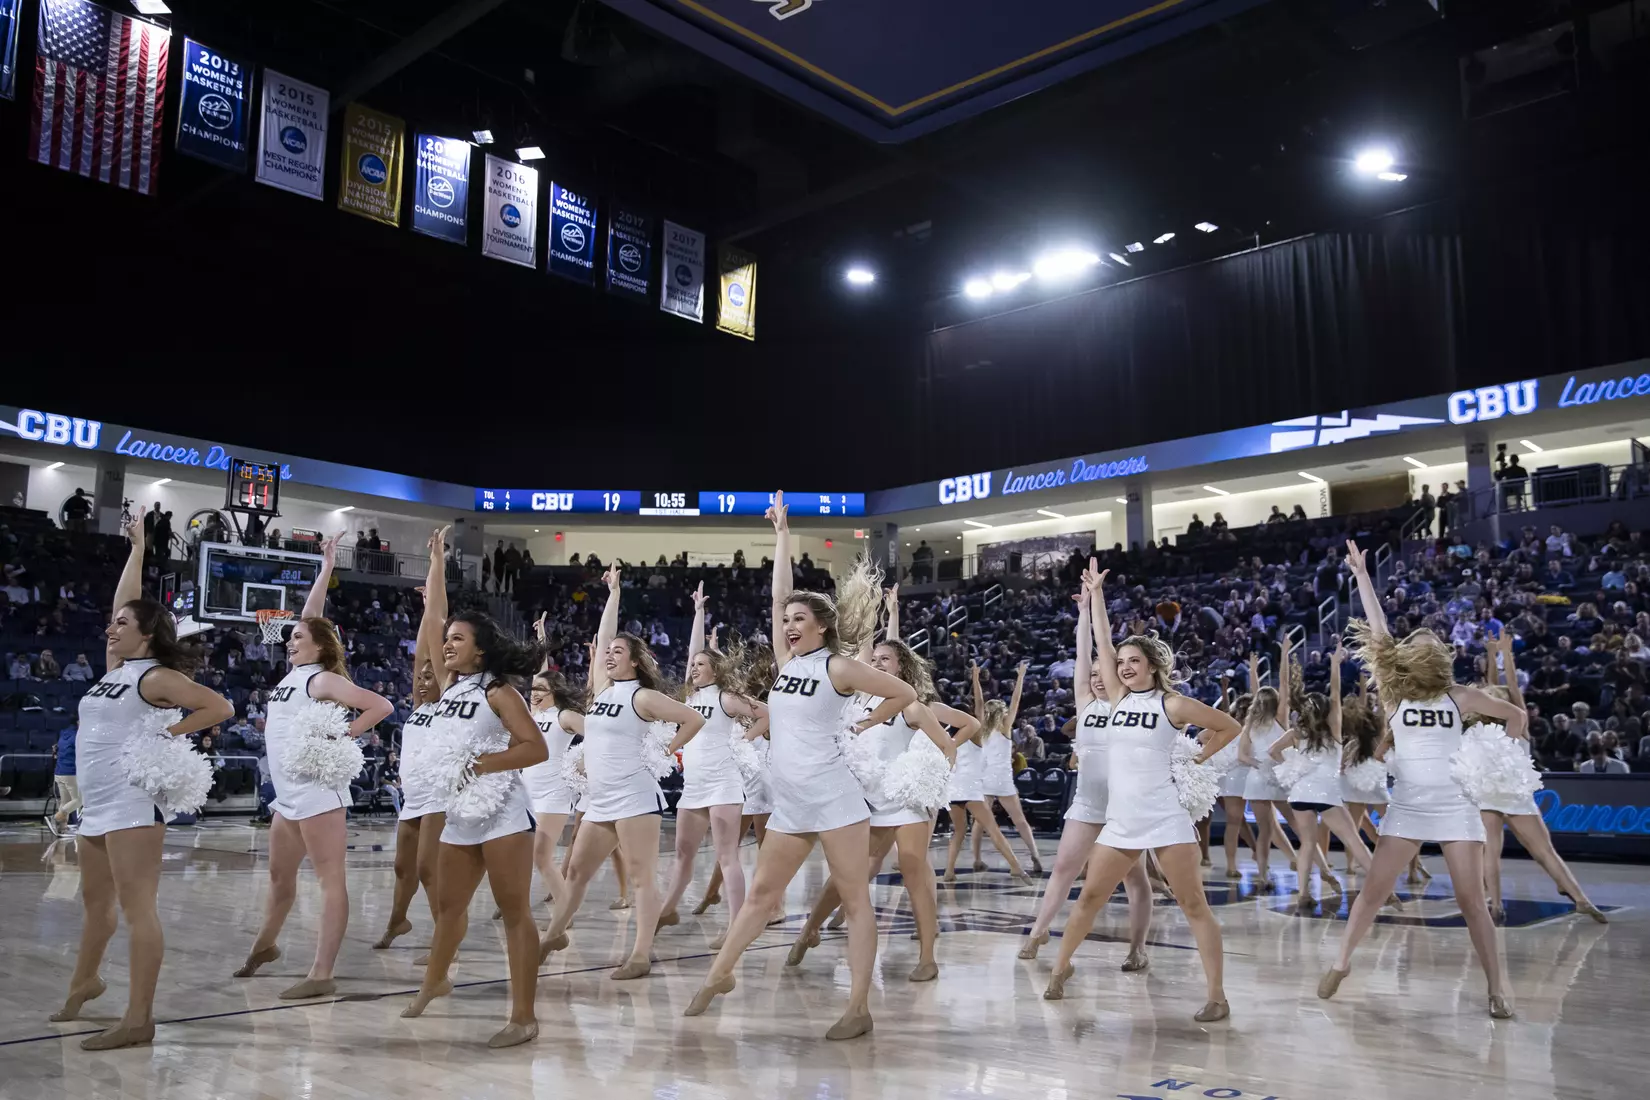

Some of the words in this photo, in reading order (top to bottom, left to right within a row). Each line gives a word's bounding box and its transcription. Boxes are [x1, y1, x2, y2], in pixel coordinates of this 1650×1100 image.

[200, 50, 239, 76] 2013
[192, 63, 243, 89] WOMEN'S
[279, 84, 314, 106] 2015
[272, 97, 317, 119] WOMEN'S
[266, 105, 325, 132] BASKETBALL
[358, 115, 391, 136] 2015
[182, 123, 245, 151] CHAMPIONS
[264, 150, 286, 163] WEST
[288, 155, 321, 174] REGION
[264, 160, 317, 182] CHAMPIONS
[417, 158, 466, 181] BASKETBALL
[497, 167, 525, 185] 2016
[347, 181, 387, 199] DIVISION
[488, 186, 534, 207] BASKETBALL
[492, 179, 528, 196] WOMEN'S
[561, 188, 588, 207] 2017
[343, 197, 381, 214] RUNNER
[347, 188, 393, 209] NATIONAL
[556, 199, 590, 218] WOMEN'S
[415, 204, 464, 226] CHAMPIONS
[553, 207, 596, 229] BASKETBALL
[618, 211, 644, 228] 2017
[486, 233, 534, 253] TOURNAMENT
[492, 228, 522, 244] DIVISION
[551, 249, 594, 268] CHAMPIONS
[1448, 379, 1539, 425] CBU
[18, 409, 101, 449] CBU
[115, 430, 200, 466] Lancer
[939, 472, 992, 505] CBU
[1002, 468, 1066, 495] Lancer
[1070, 456, 1149, 483] Dancers
[483, 501, 494, 510] FLS
[505, 502, 510, 510] 2
[484, 491, 495, 499] TOL
[505, 491, 511, 500] 4
[531, 492, 574, 511] CBU
[603, 492, 621, 511] 19
[654, 492, 686, 508] 10:55
[718, 494, 736, 513] 19
[841, 495, 847, 504] 3
[819, 505, 831, 514] FLS
[772, 675, 820, 697] CBU
[434, 699, 480, 719] CBU
[587, 702, 624, 718] CBU
[1403, 708, 1454, 728] CBU
[1112, 711, 1159, 729] CBU
